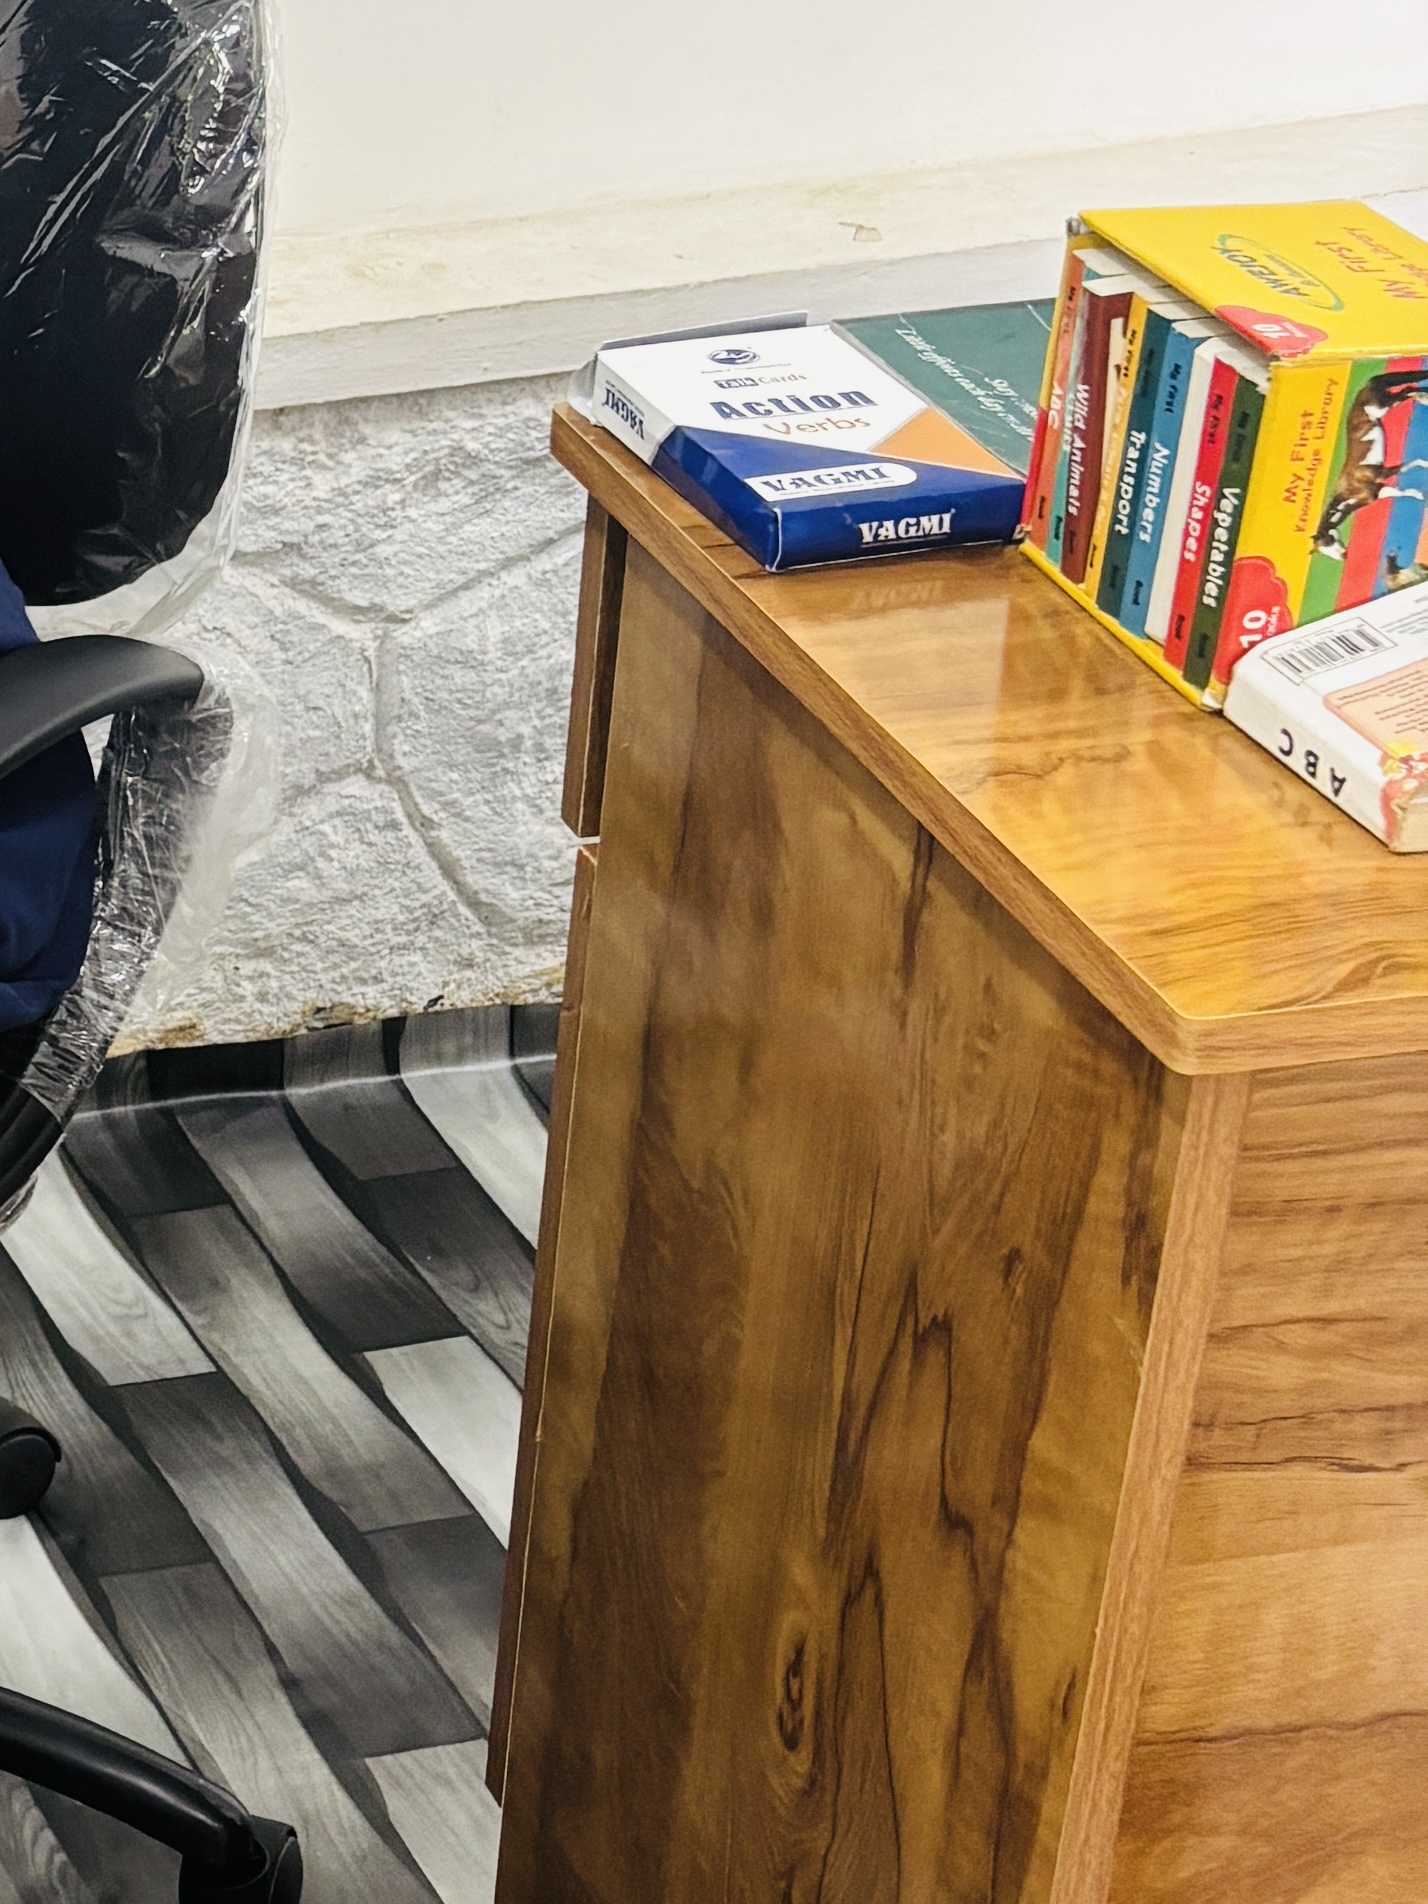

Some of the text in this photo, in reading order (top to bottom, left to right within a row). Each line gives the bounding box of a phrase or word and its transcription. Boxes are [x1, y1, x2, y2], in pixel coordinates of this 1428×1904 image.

[602, 387, 645, 440] VAGMI
[710, 391, 878, 420] Action
[763, 417, 871, 435] Verbs
[1047, 381, 1064, 430] ABC
[1073, 383, 1091, 430] Wild
[760, 467, 891, 493] VAGMI
[1068, 433, 1087, 516] Animals
[1282, 410, 1315, 504] My First
[1294, 378, 1340, 533] Knowledge Library
[1114, 430, 1147, 536] Transport
[1139, 441, 1171, 544] Numbers
[858, 511, 952, 544] VAGMI
[1183, 481, 1212, 562] Shapes
[1239, 609, 1267, 649] 10
